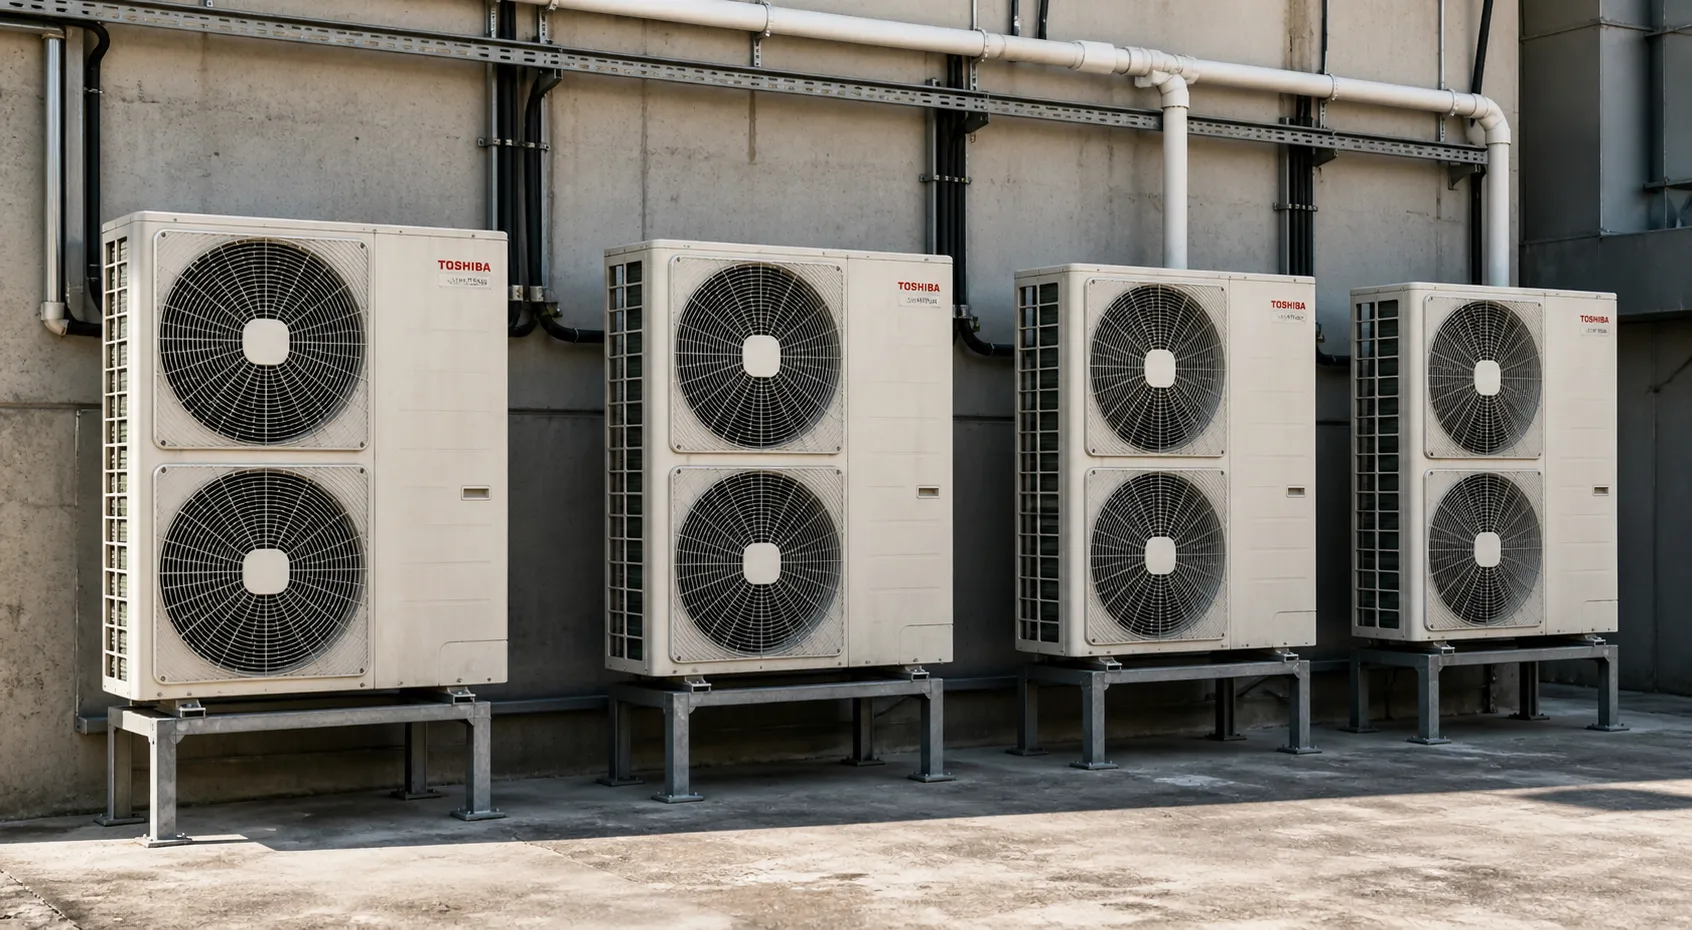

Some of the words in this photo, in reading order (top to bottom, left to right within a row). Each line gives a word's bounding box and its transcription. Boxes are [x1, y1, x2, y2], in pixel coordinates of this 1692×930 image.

[438, 260, 491, 272] TOSHIBA
[898, 282, 941, 292] TOSHIBA
[1271, 300, 1306, 310] TOSHIBA
[1580, 315, 1609, 323] TOSHIBA
